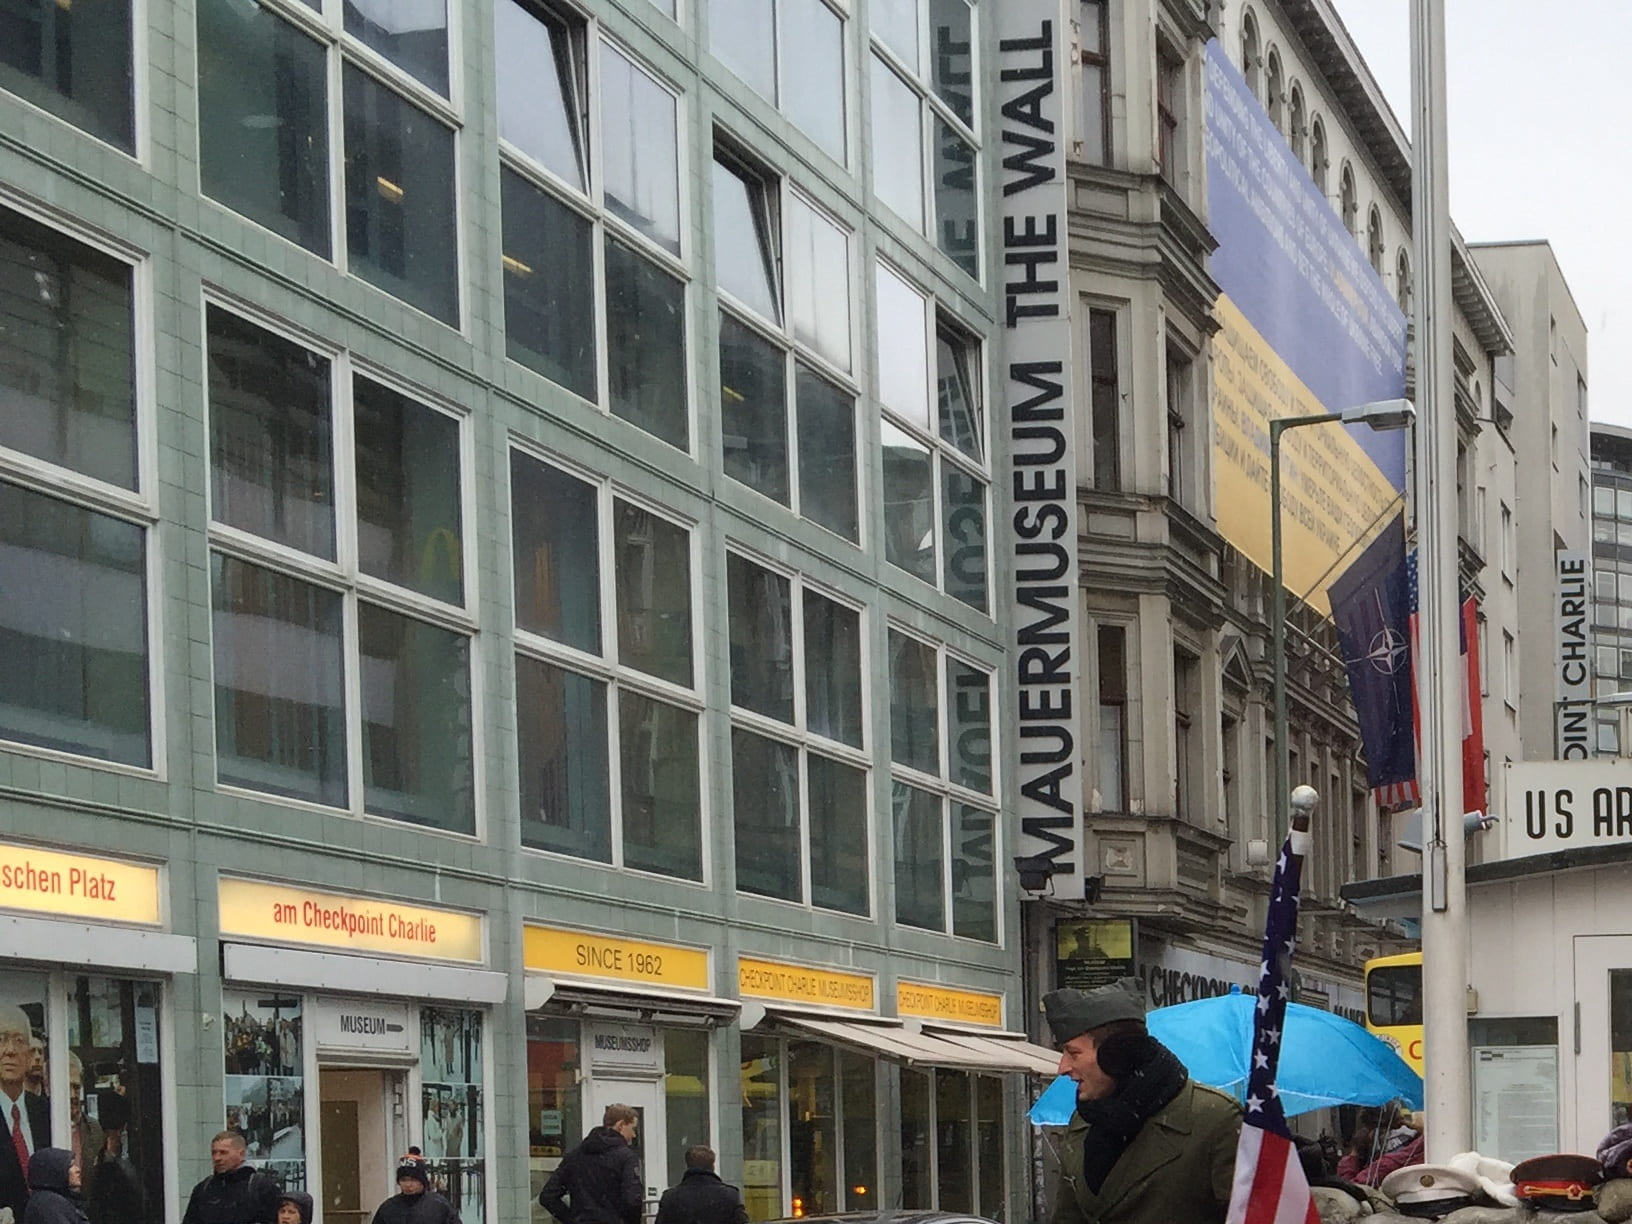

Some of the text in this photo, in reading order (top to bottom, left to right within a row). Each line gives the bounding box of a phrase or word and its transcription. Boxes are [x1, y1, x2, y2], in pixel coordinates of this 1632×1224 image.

[999, 20, 1075, 875] MAUERMUSEUM THE WALL
[1561, 559, 1587, 686] CHARLIE
[69, 868, 116, 901] Platz
[273, 900, 437, 943] am Checkpoint Charlie
[576, 944, 662, 976] SINCE 1962
[340, 1014, 385, 1035] MUSEUM
